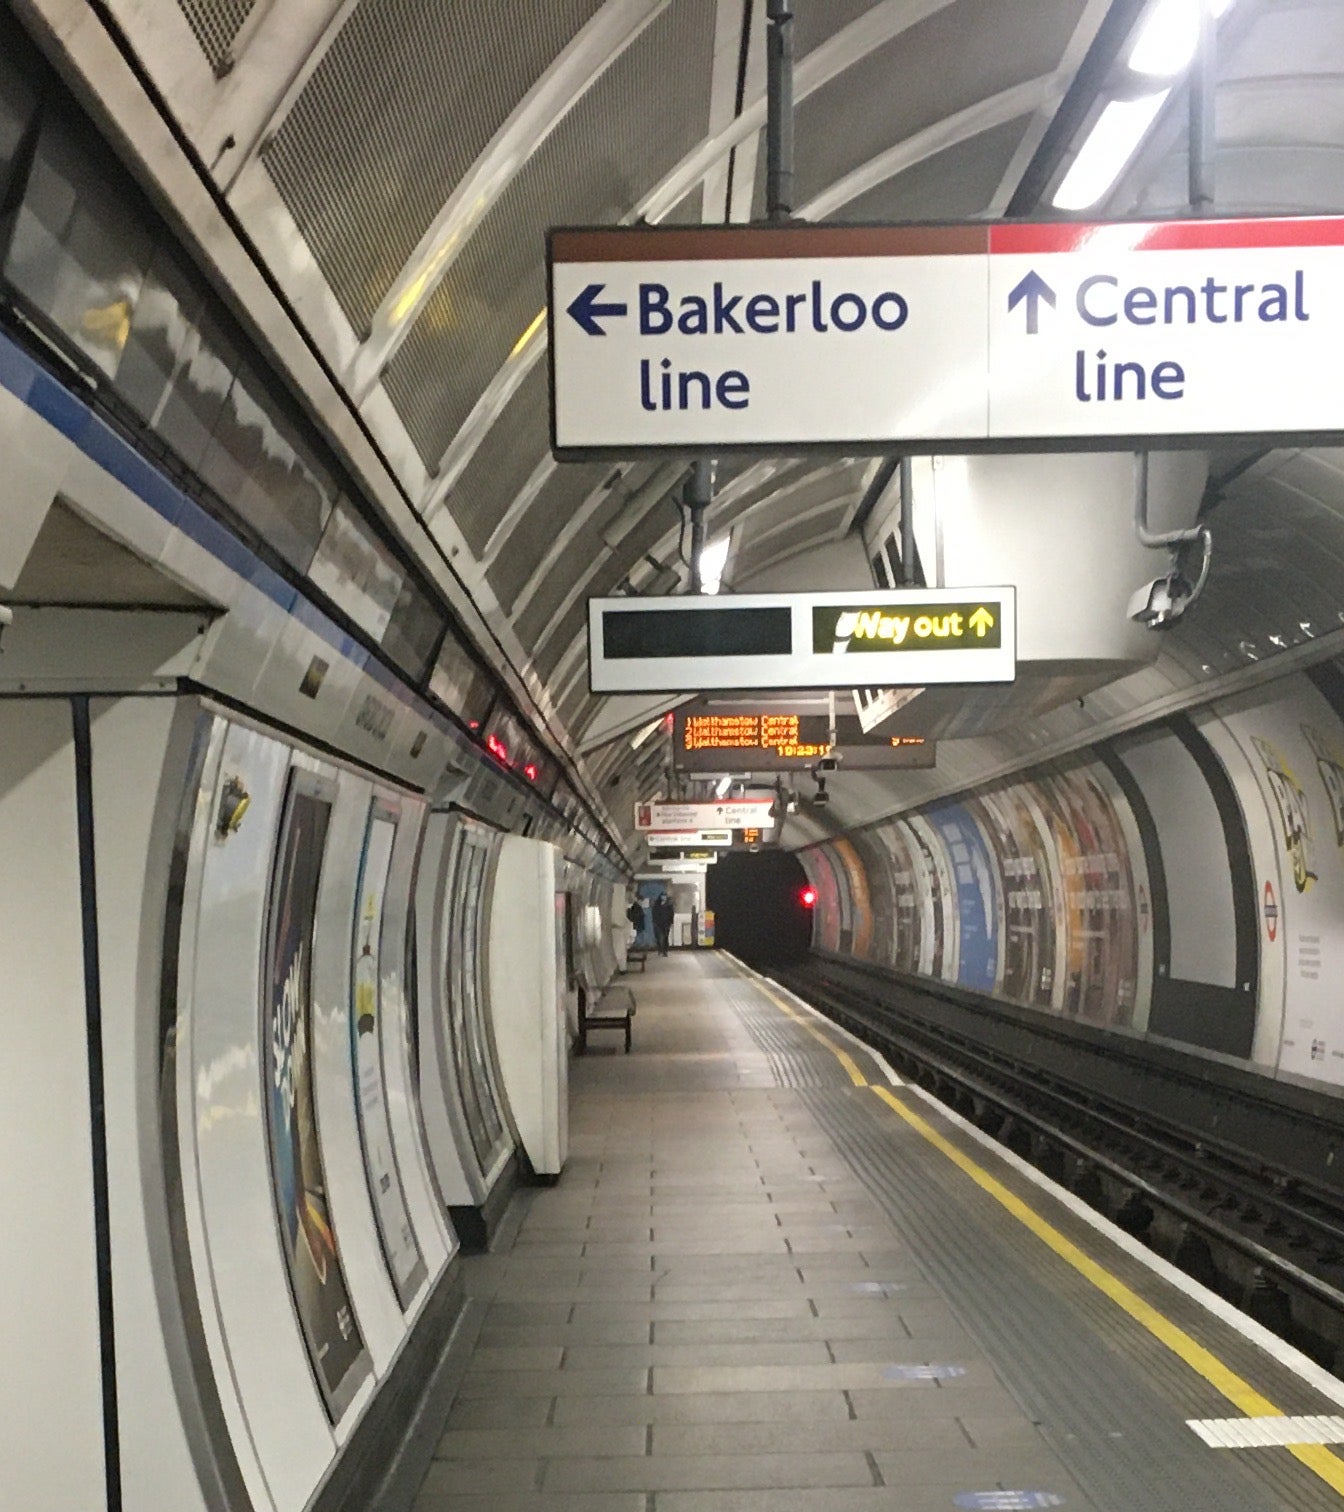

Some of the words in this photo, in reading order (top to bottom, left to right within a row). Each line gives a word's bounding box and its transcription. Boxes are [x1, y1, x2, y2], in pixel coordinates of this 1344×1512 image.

[639, 281, 908, 335] Bakerloo
[1076, 270, 1310, 327] Central
[641, 358, 750, 411] line
[1076, 349, 1186, 402] line
[854, 611, 910, 644] Way
[914, 613, 963, 637] out
[761, 715, 799, 727] Central
[761, 726, 798, 737] Central
[761, 736, 798, 747] Central
